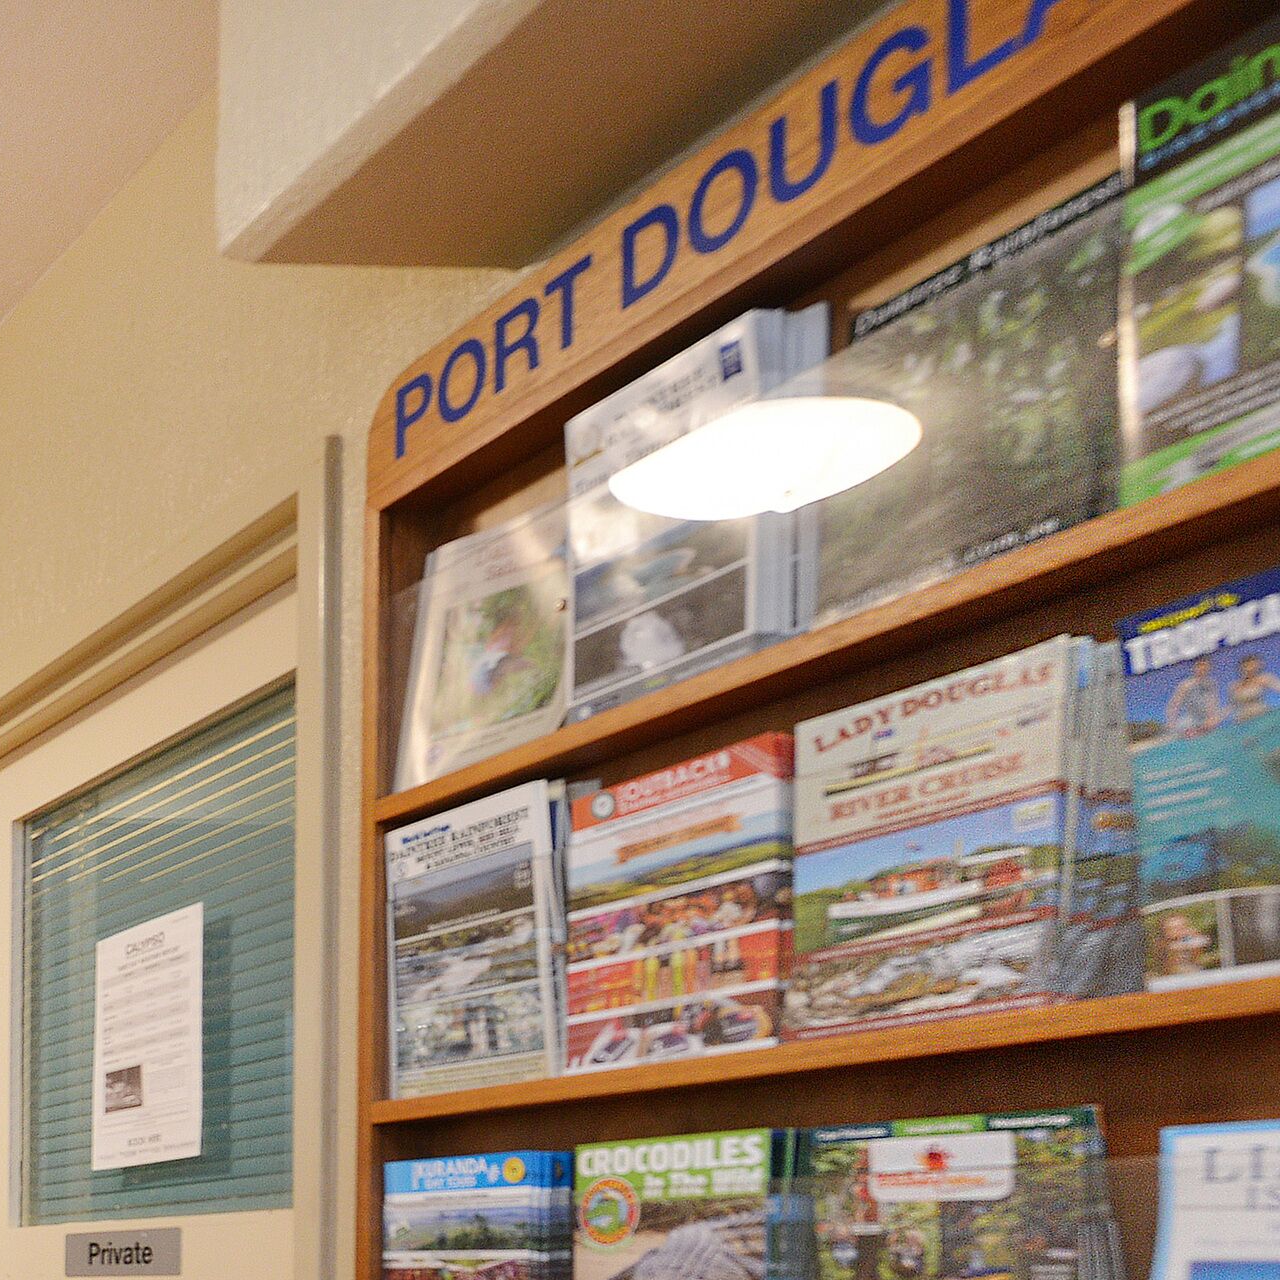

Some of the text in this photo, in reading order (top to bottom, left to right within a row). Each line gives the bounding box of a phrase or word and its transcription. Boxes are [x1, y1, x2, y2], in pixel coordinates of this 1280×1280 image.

[395, 0, 1062, 459] PORT DOUGL
[813, 703, 895, 754] LADY
[578, 1134, 763, 1176] CROCODILES
[88, 1241, 153, 1268] Private
